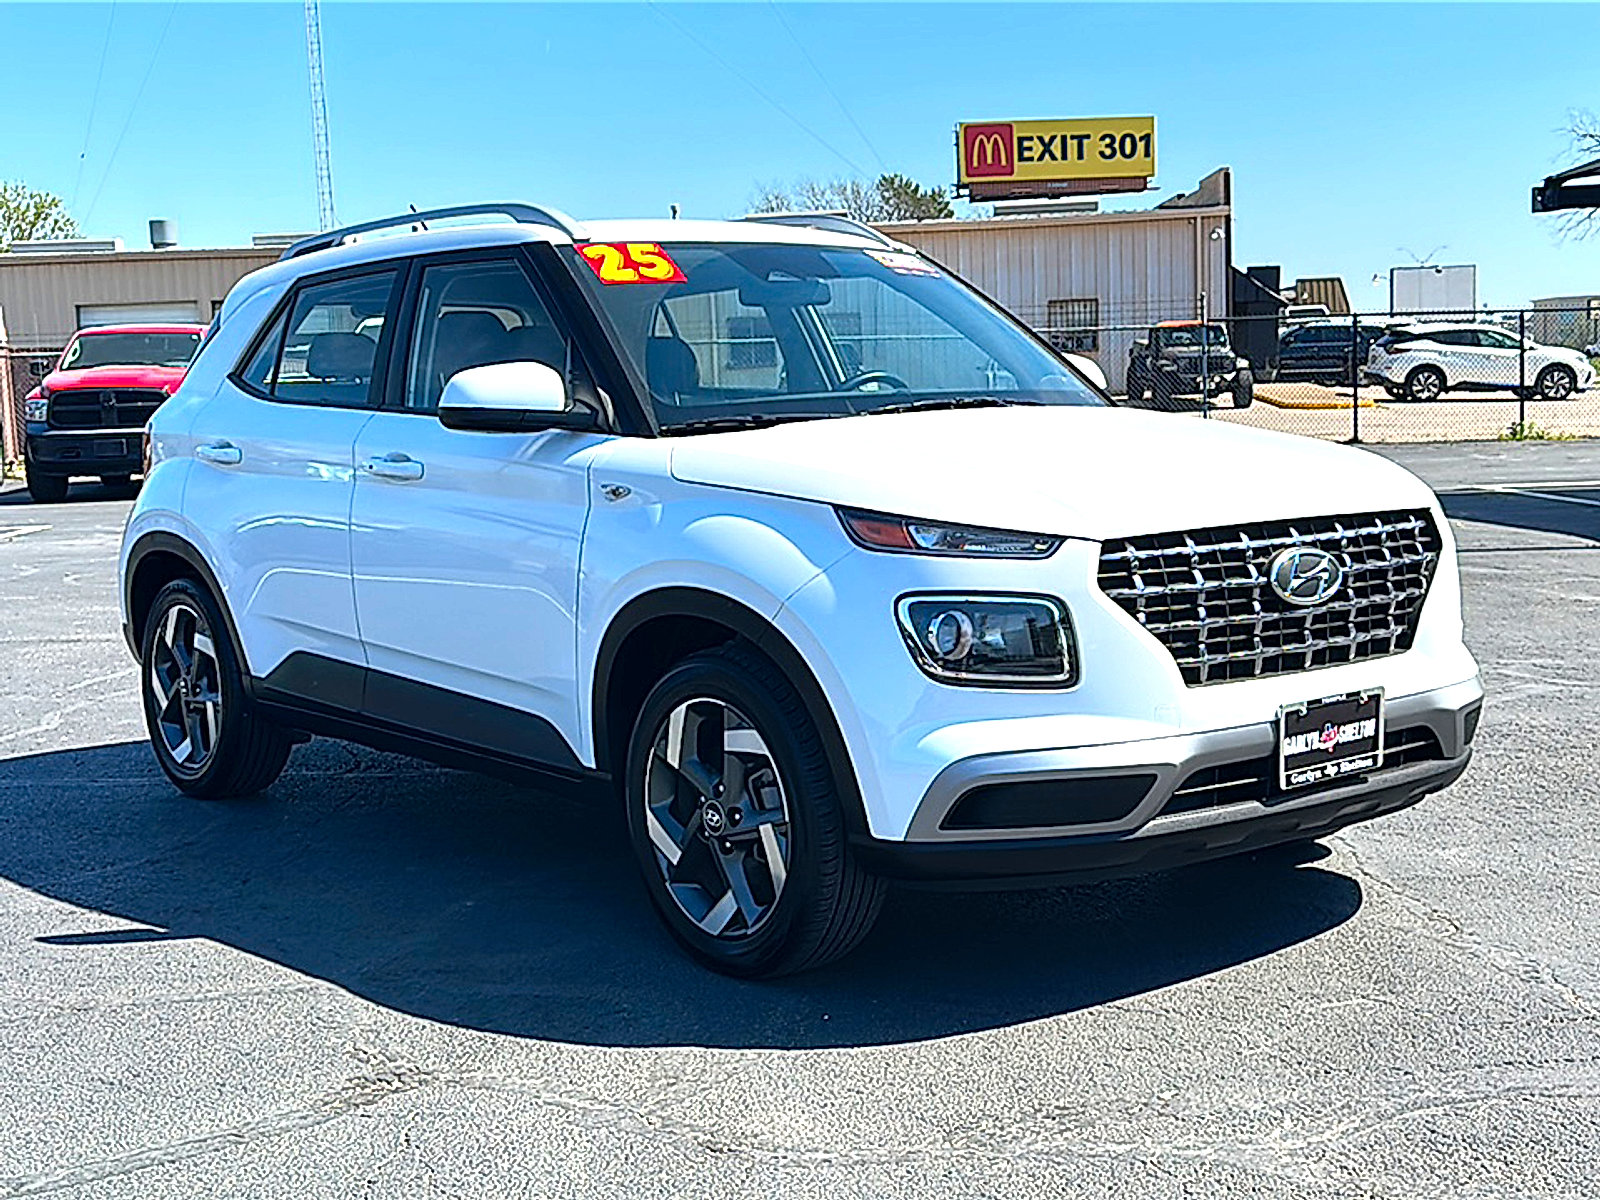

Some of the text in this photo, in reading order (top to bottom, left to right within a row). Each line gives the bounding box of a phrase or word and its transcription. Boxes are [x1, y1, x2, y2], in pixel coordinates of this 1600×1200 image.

[1016, 132, 1152, 163] EXIT 301
[582, 243, 675, 282] 25
